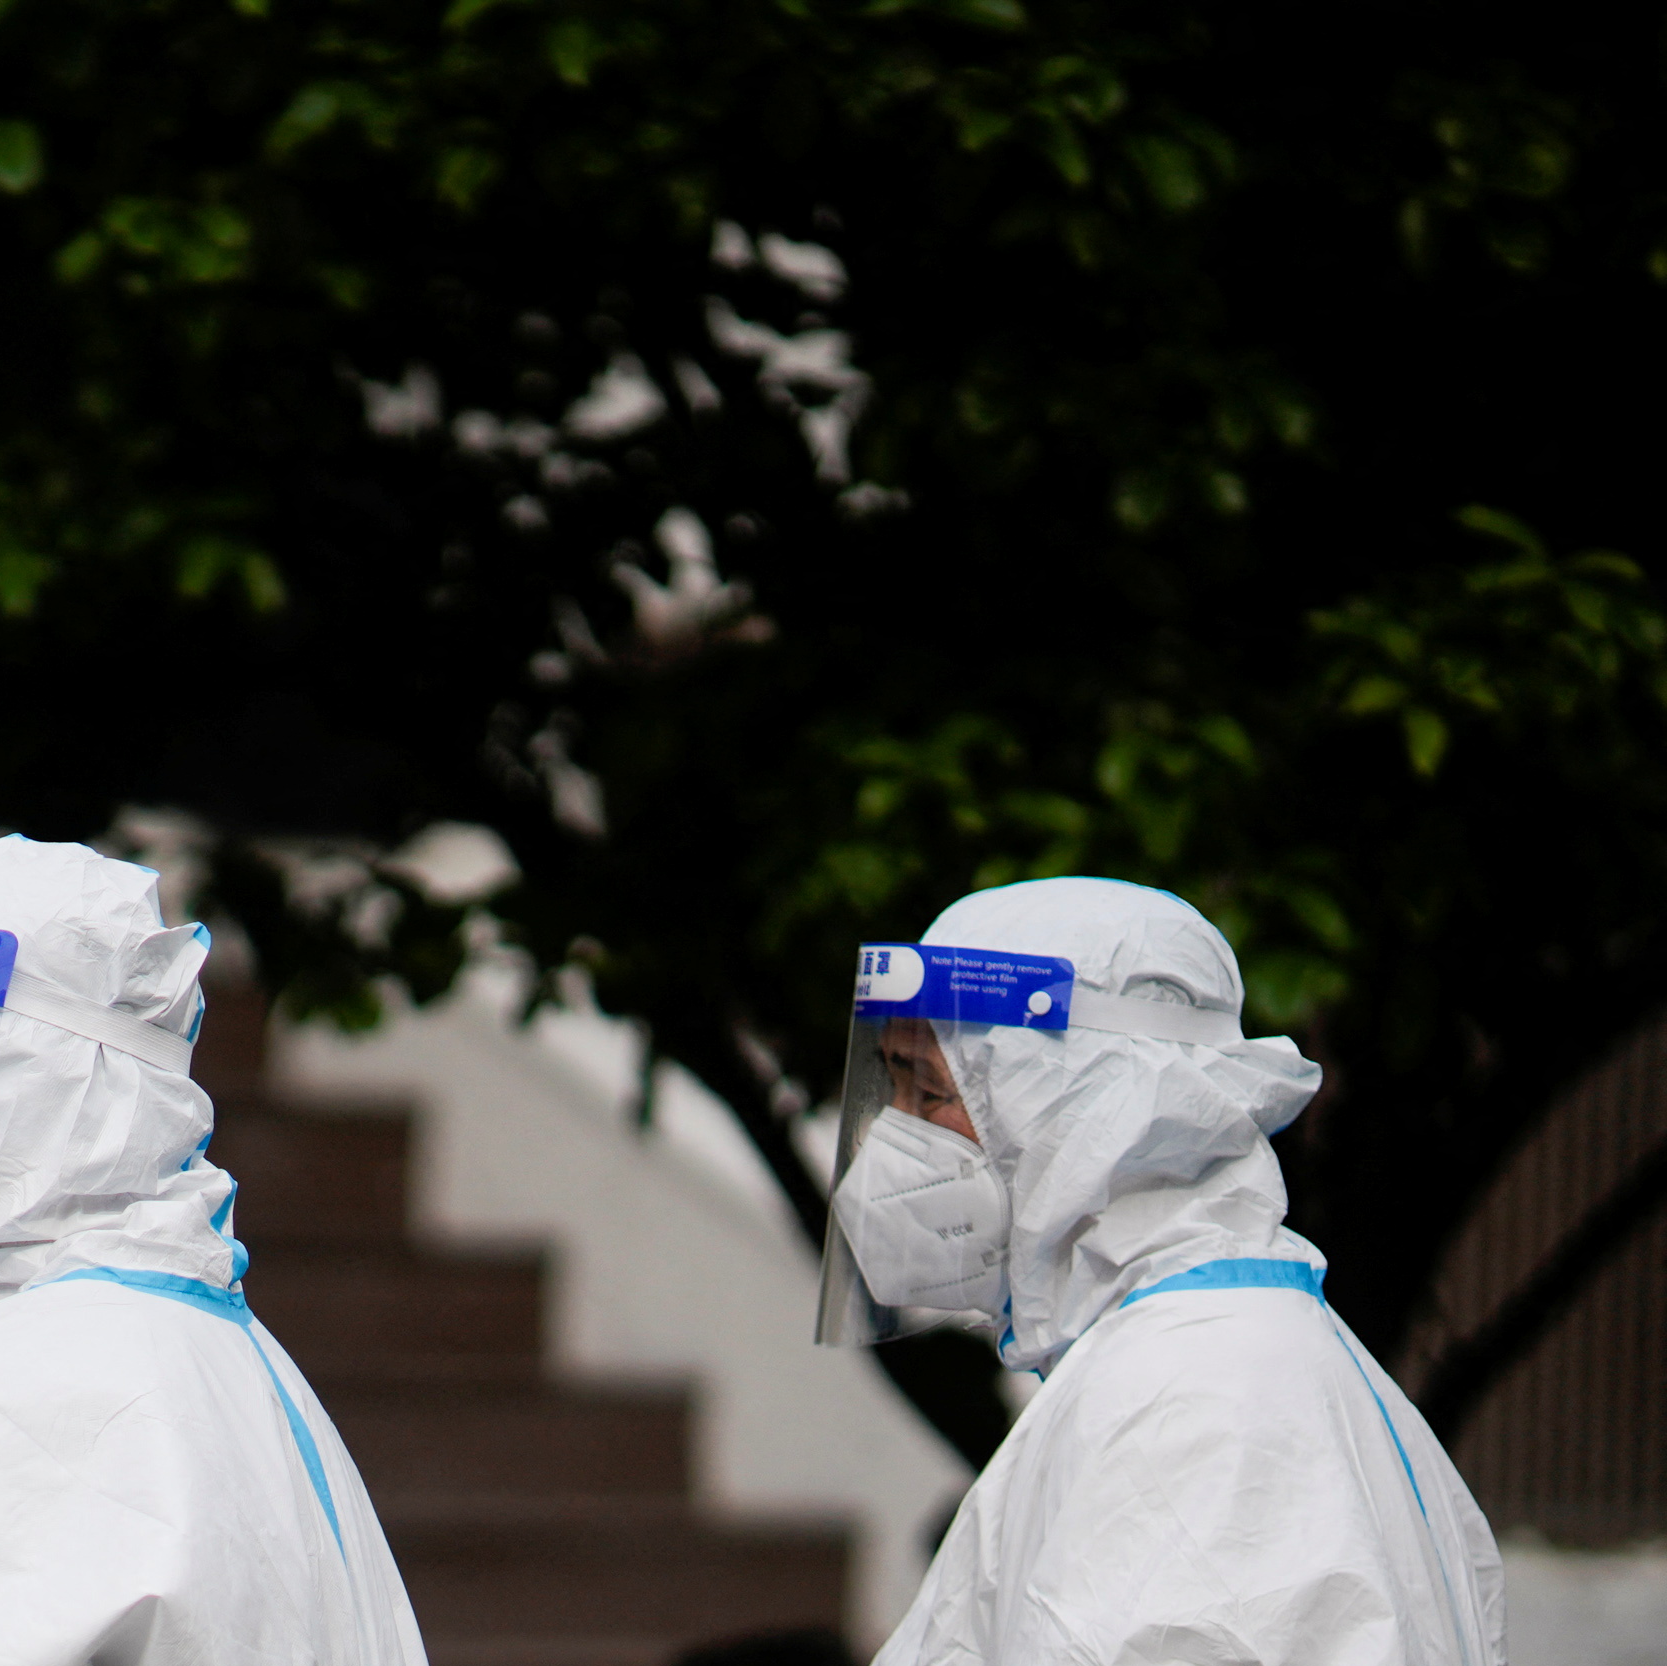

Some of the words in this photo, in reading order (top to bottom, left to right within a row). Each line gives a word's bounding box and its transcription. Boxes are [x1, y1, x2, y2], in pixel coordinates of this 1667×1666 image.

[954, 956, 983, 968] Please
[985, 961, 1015, 974] gently
[1016, 965, 1052, 976] remove
[951, 970, 997, 982] protective
[999, 973, 1018, 984] film
[950, 981, 979, 992] before
[982, 985, 1007, 998] using
